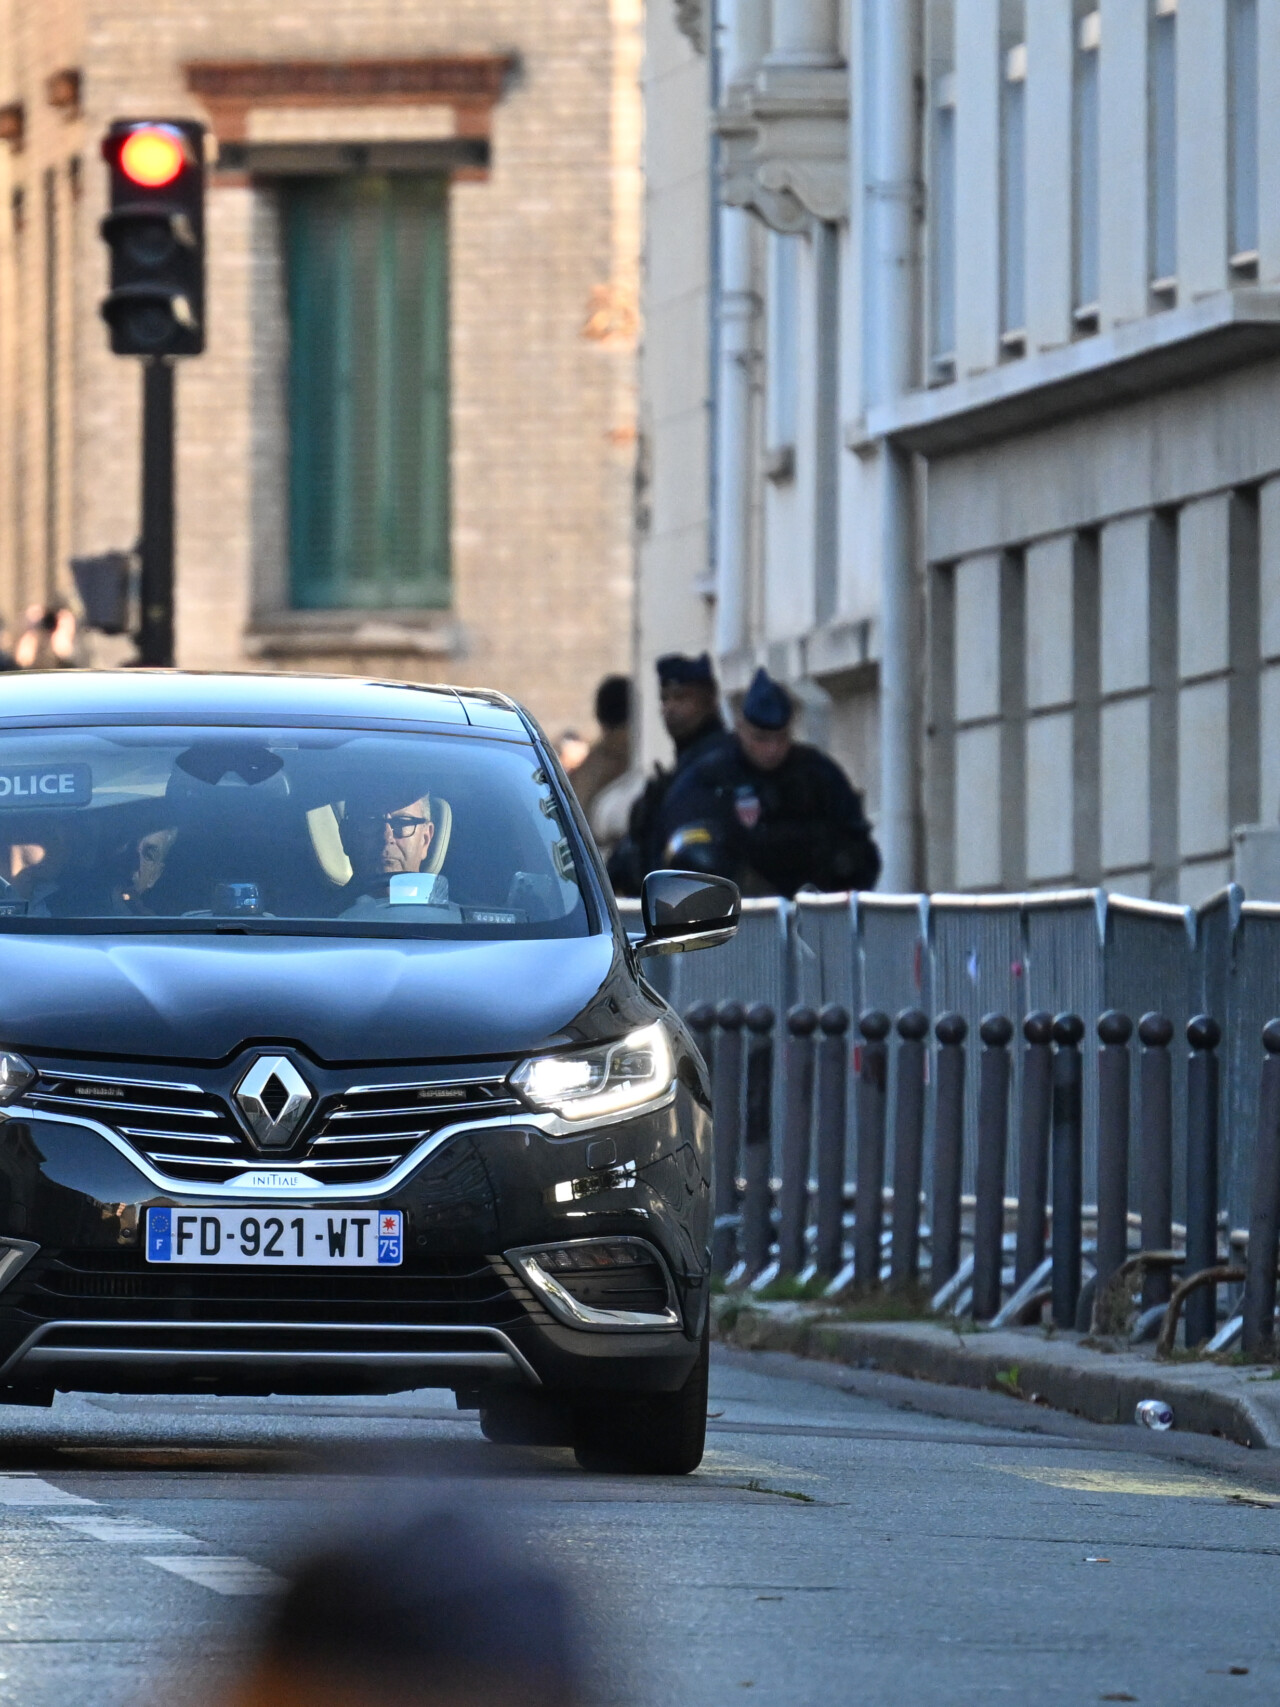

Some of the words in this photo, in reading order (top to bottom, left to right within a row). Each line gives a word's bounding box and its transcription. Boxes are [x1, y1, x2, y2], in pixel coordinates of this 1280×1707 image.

[253, 1173, 298, 1186] INITIALE
[156, 1239, 163, 1250] F
[176, 1216, 371, 1258] FD-921-WT
[380, 1239, 399, 1258] 75
